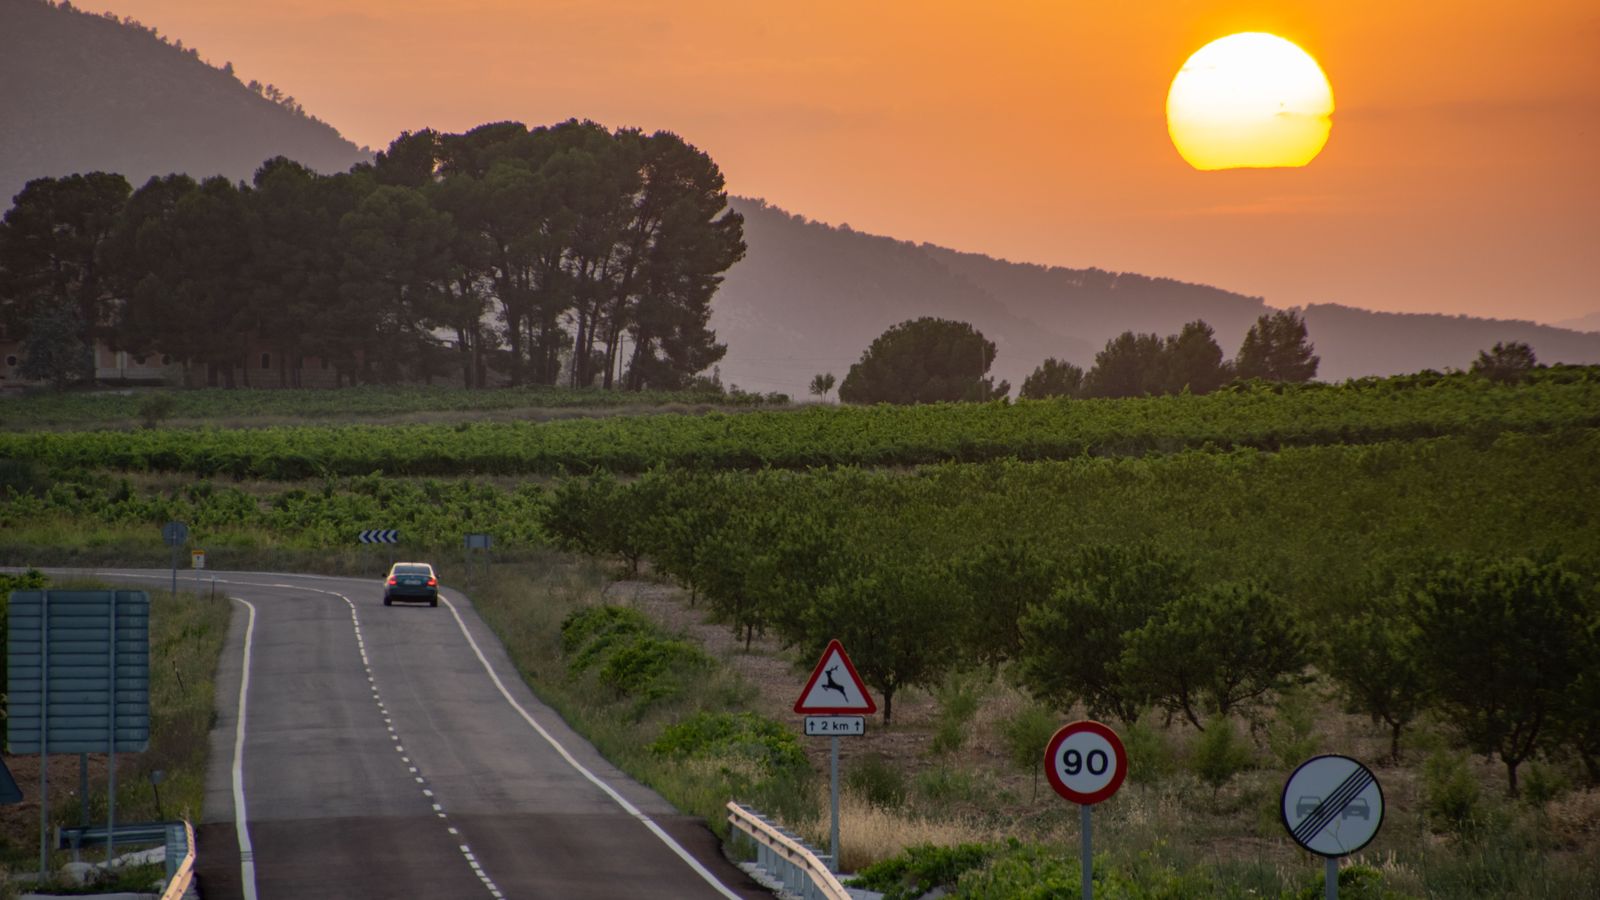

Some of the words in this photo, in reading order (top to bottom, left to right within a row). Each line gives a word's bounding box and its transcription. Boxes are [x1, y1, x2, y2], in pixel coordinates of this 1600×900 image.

[821, 721, 828, 731] 2
[832, 721, 849, 731] km
[1063, 749, 1109, 776] 90
